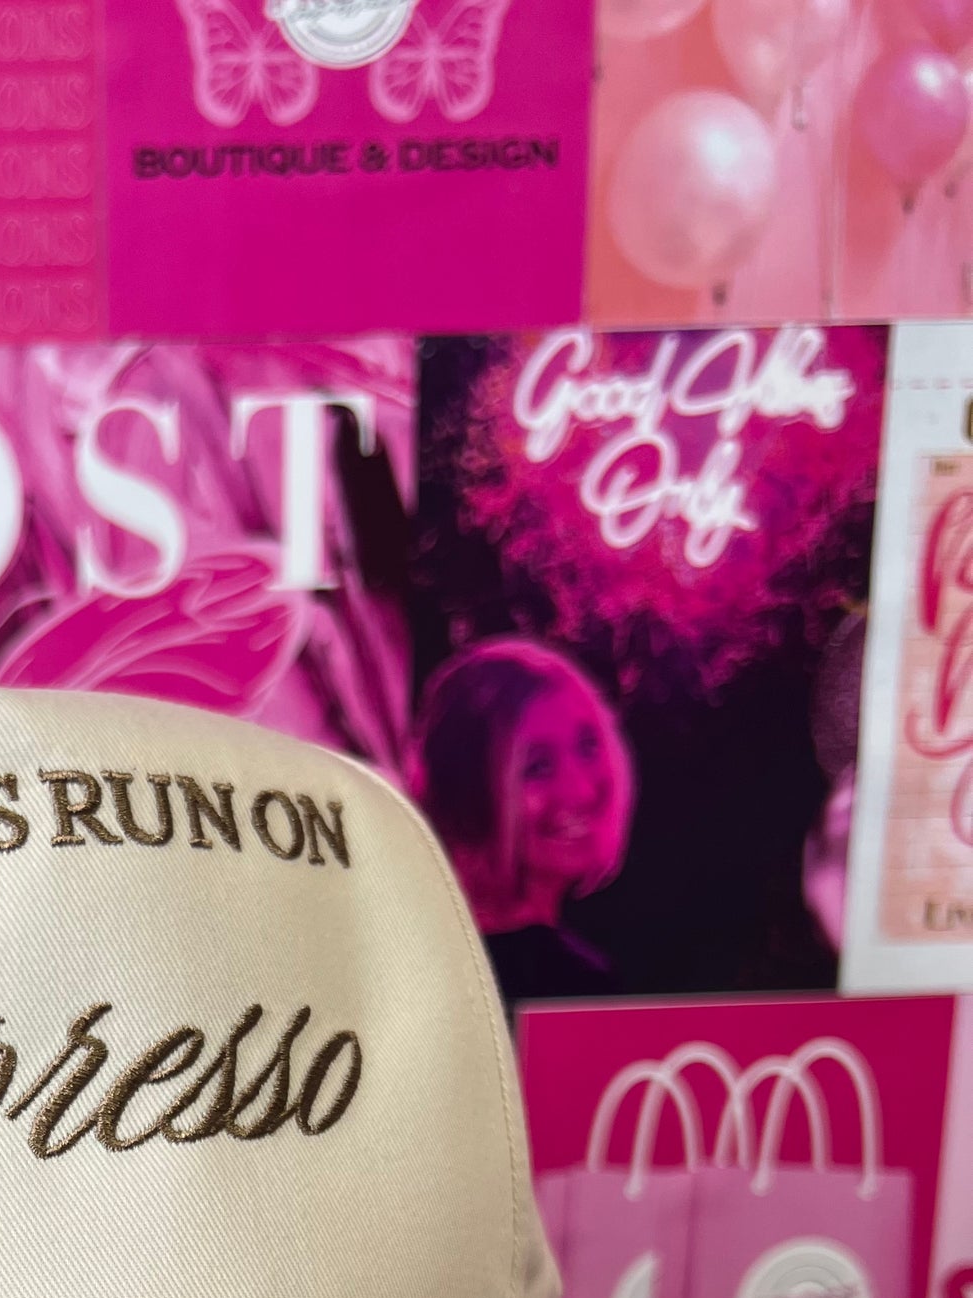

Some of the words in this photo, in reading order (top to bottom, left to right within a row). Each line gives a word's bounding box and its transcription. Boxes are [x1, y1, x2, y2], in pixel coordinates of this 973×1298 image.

[133, 140, 348, 180] BOUTIQUE
[358, 139, 389, 174] &
[397, 136, 559, 172] DESIGN
[513, 327, 682, 464] Good
[39, 767, 244, 853] RUN
[250, 789, 352, 869] ON
